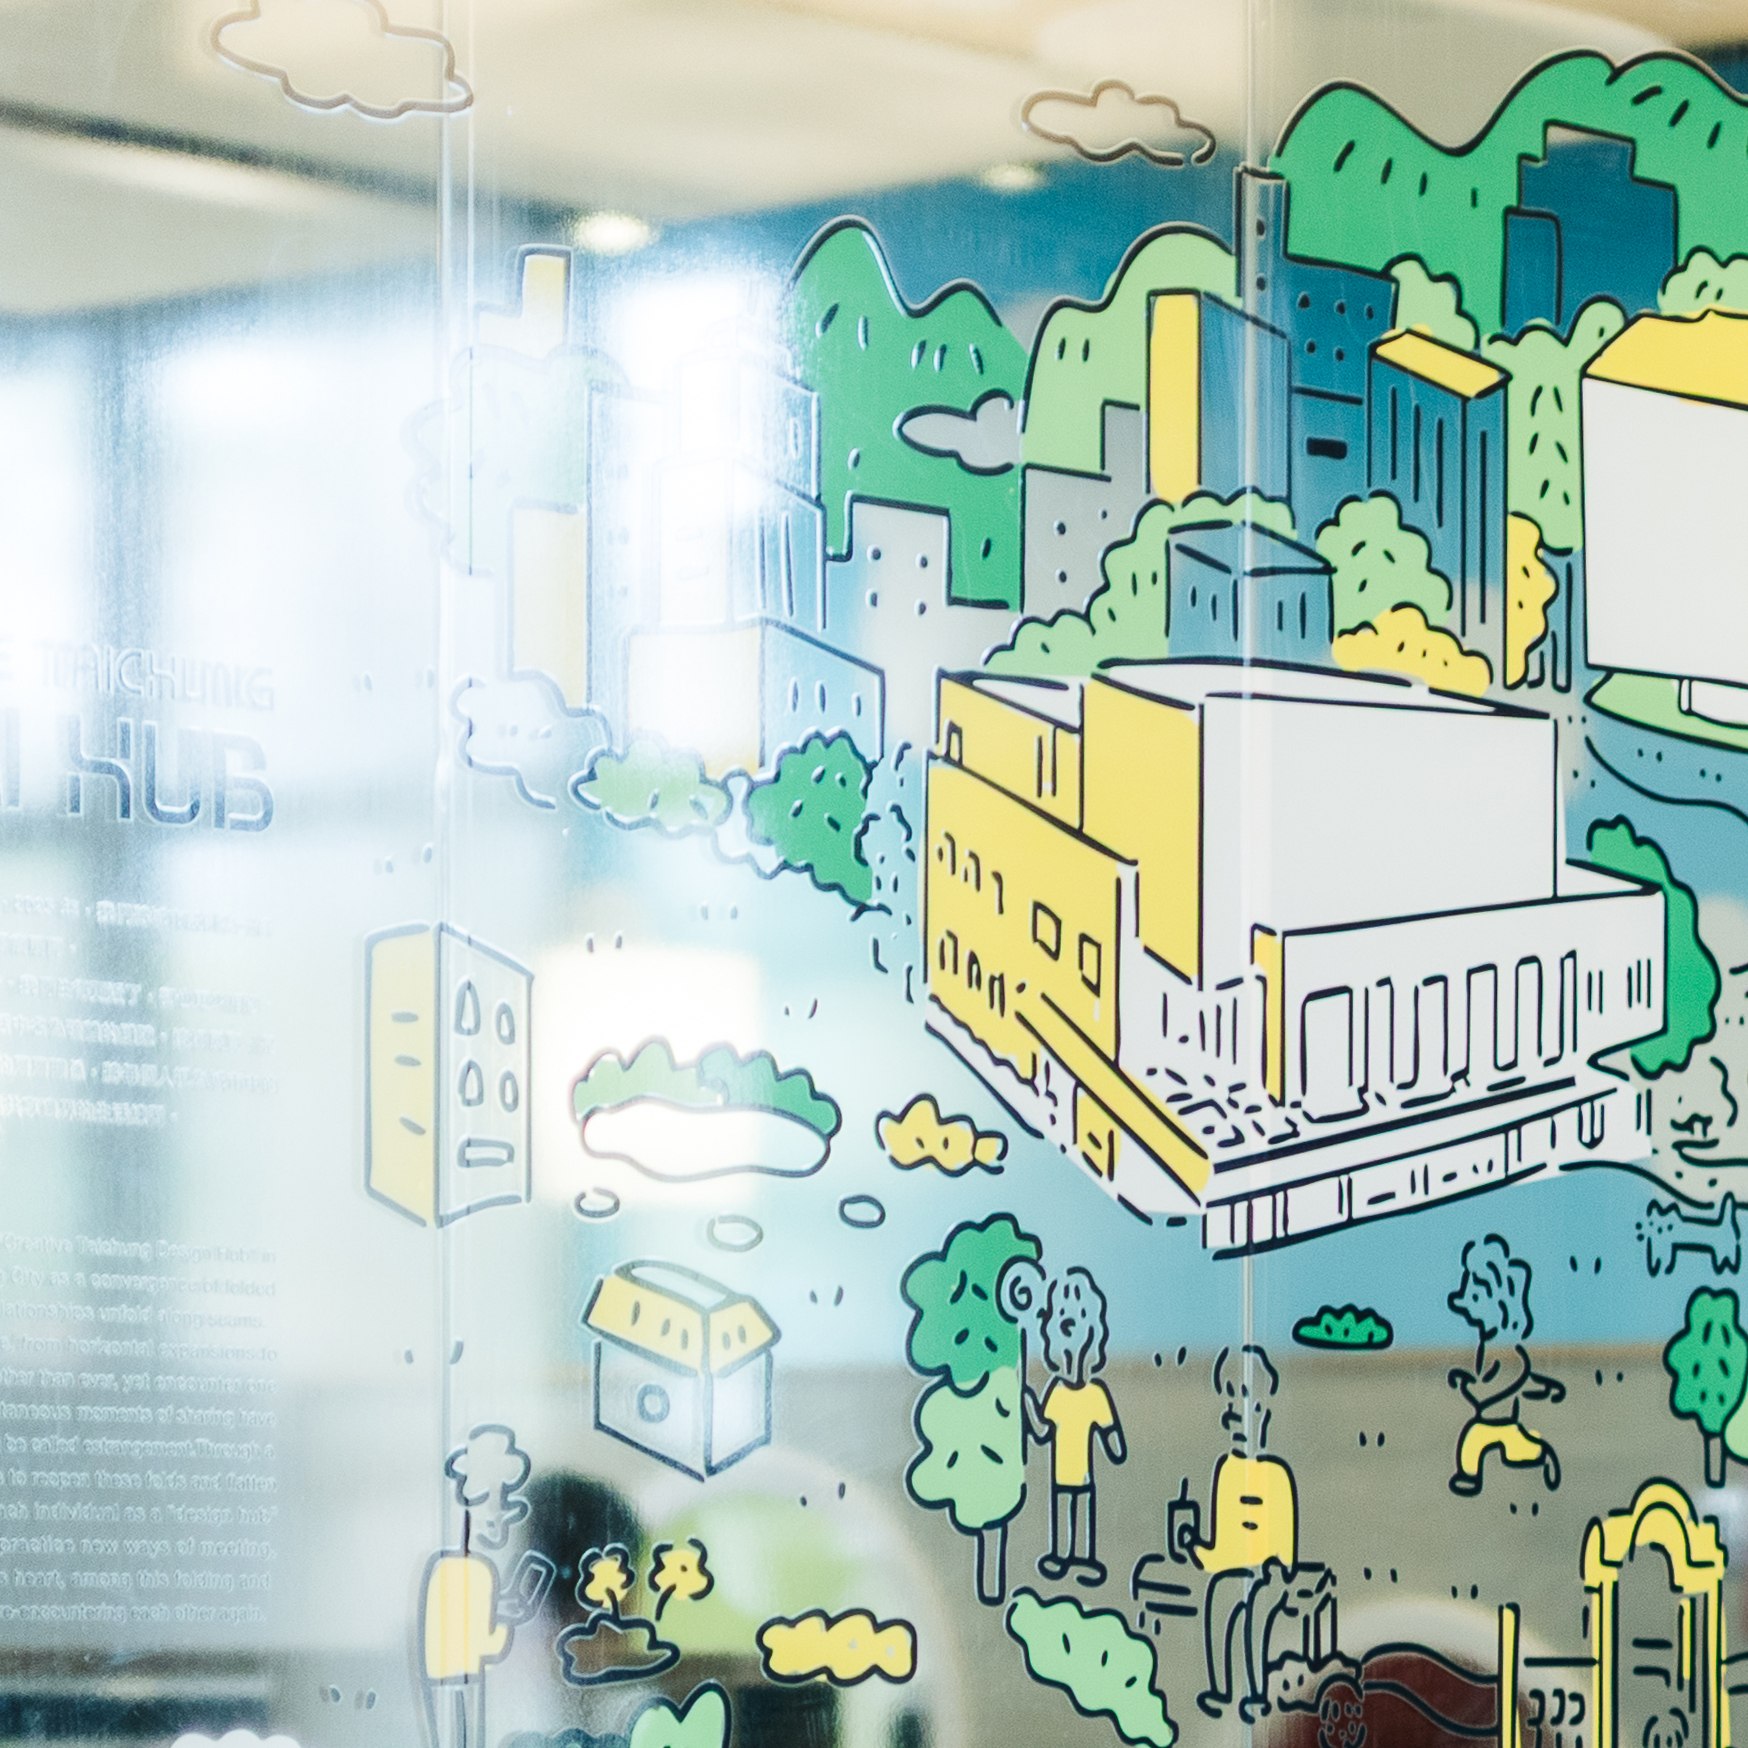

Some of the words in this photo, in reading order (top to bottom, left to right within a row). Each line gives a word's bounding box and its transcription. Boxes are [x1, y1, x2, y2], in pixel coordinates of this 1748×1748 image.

[37, 640, 275, 710] TAICHUNG
[64, 714, 274, 832] HUB
[75, 1235, 152, 1260] Taichung
[224, 1279, 277, 1297] folded
[0, 1300, 95, 1323] lationships
[39, 1368, 75, 1388] than
[0, 1402, 71, 1422] taneous
[76, 1404, 153, 1422] moments
[176, 1406, 236, 1428] sharing
[238, 1409, 277, 1427] have
[94, 1470, 142, 1489] these
[191, 1473, 222, 1490] and
[34, 1502, 119, 1522] individual
[80, 1538, 118, 1555] new
[124, 1539, 172, 1558] ways
[71, 1571, 132, 1592] among
[138, 1570, 169, 1588] this
[175, 1570, 235, 1592] folding
[239, 1571, 271, 1588] and
[0, 1603, 126, 1627] e-encountering
[130, 1604, 172, 1622] each
[174, 1604, 217, 1622] other
